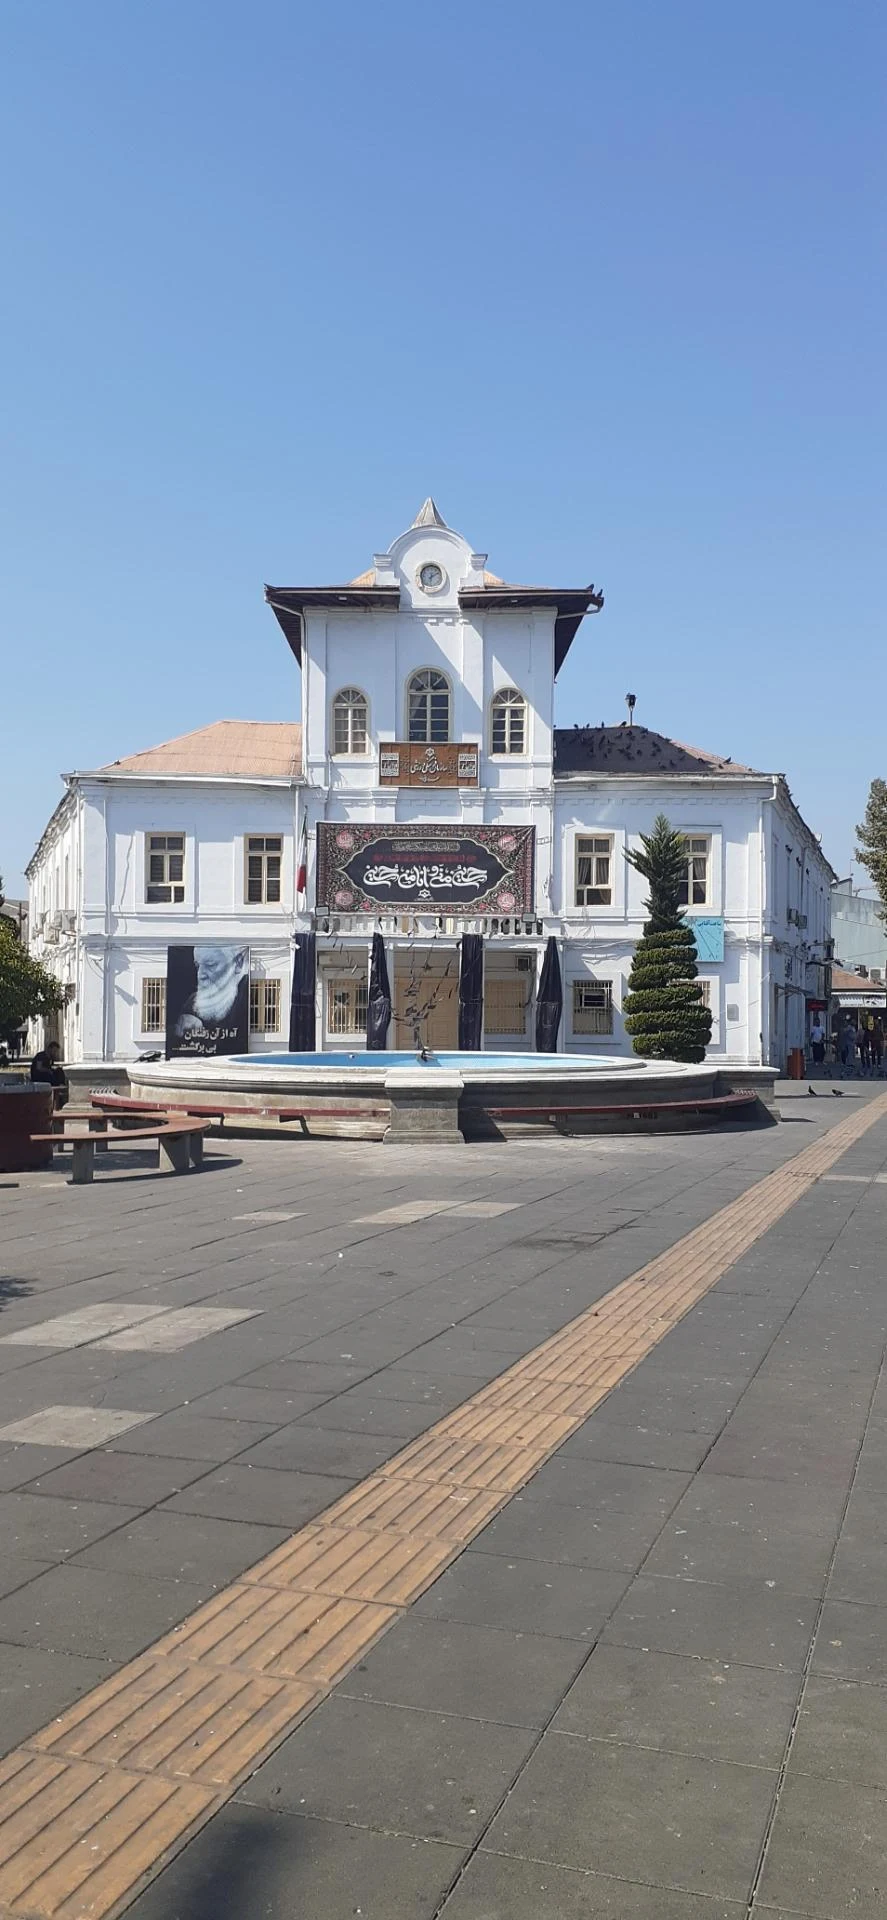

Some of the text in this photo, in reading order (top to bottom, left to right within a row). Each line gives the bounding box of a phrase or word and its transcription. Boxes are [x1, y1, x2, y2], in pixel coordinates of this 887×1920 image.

[184, 1026, 239, 1040] آه از آن رفتگان
